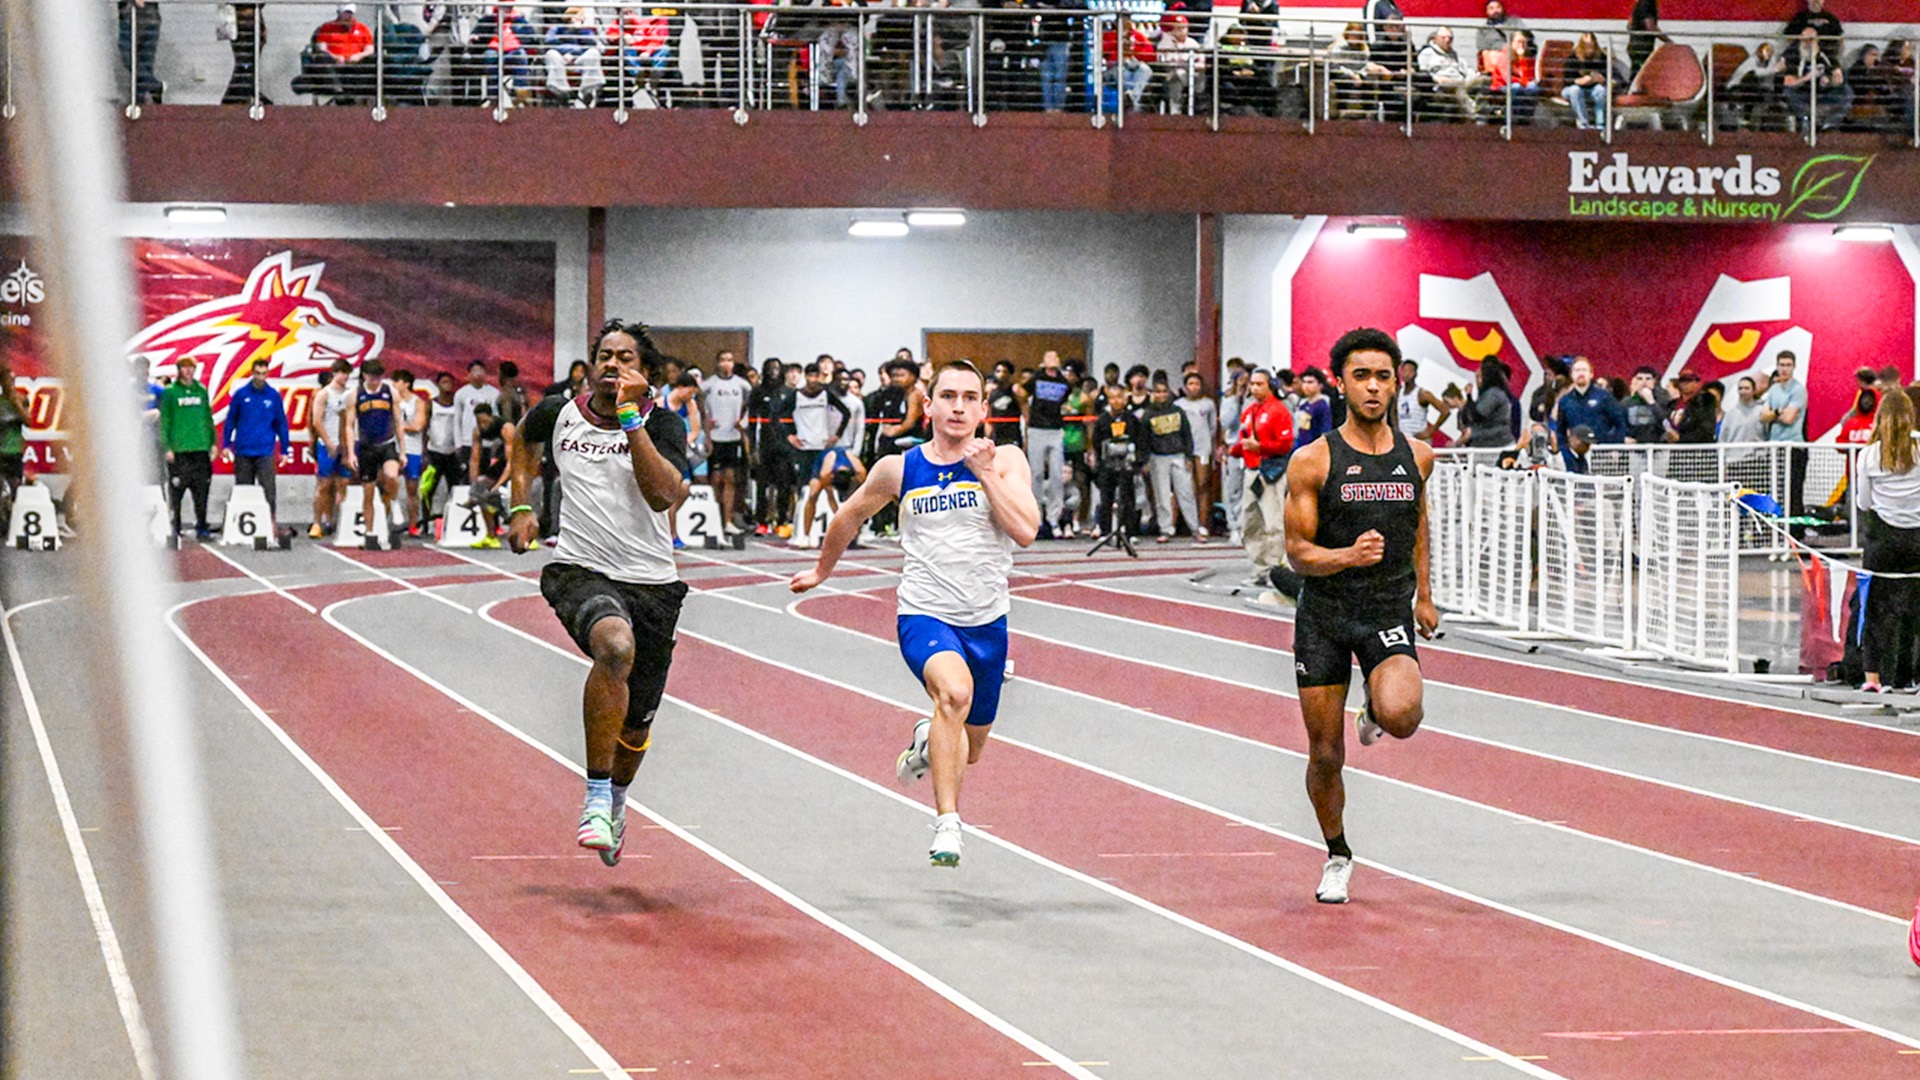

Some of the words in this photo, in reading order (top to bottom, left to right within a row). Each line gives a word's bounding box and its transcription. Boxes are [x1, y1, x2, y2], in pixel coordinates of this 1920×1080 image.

[1568, 151, 1781, 196] Edwards
[1569, 196, 1678, 219] Landscape
[1683, 197, 1697, 217] &
[1702, 199, 1782, 221] Nursery
[561, 438, 630, 456] EASTERN
[912, 490, 979, 515] WIDENER
[1341, 482, 1415, 502] STEVENS
[24, 511, 41, 537] 8
[238, 511, 257, 536] 6
[353, 512, 367, 536] 5
[460, 509, 480, 537] 4
[689, 512, 707, 536] 2
[815, 513, 827, 533] 1
